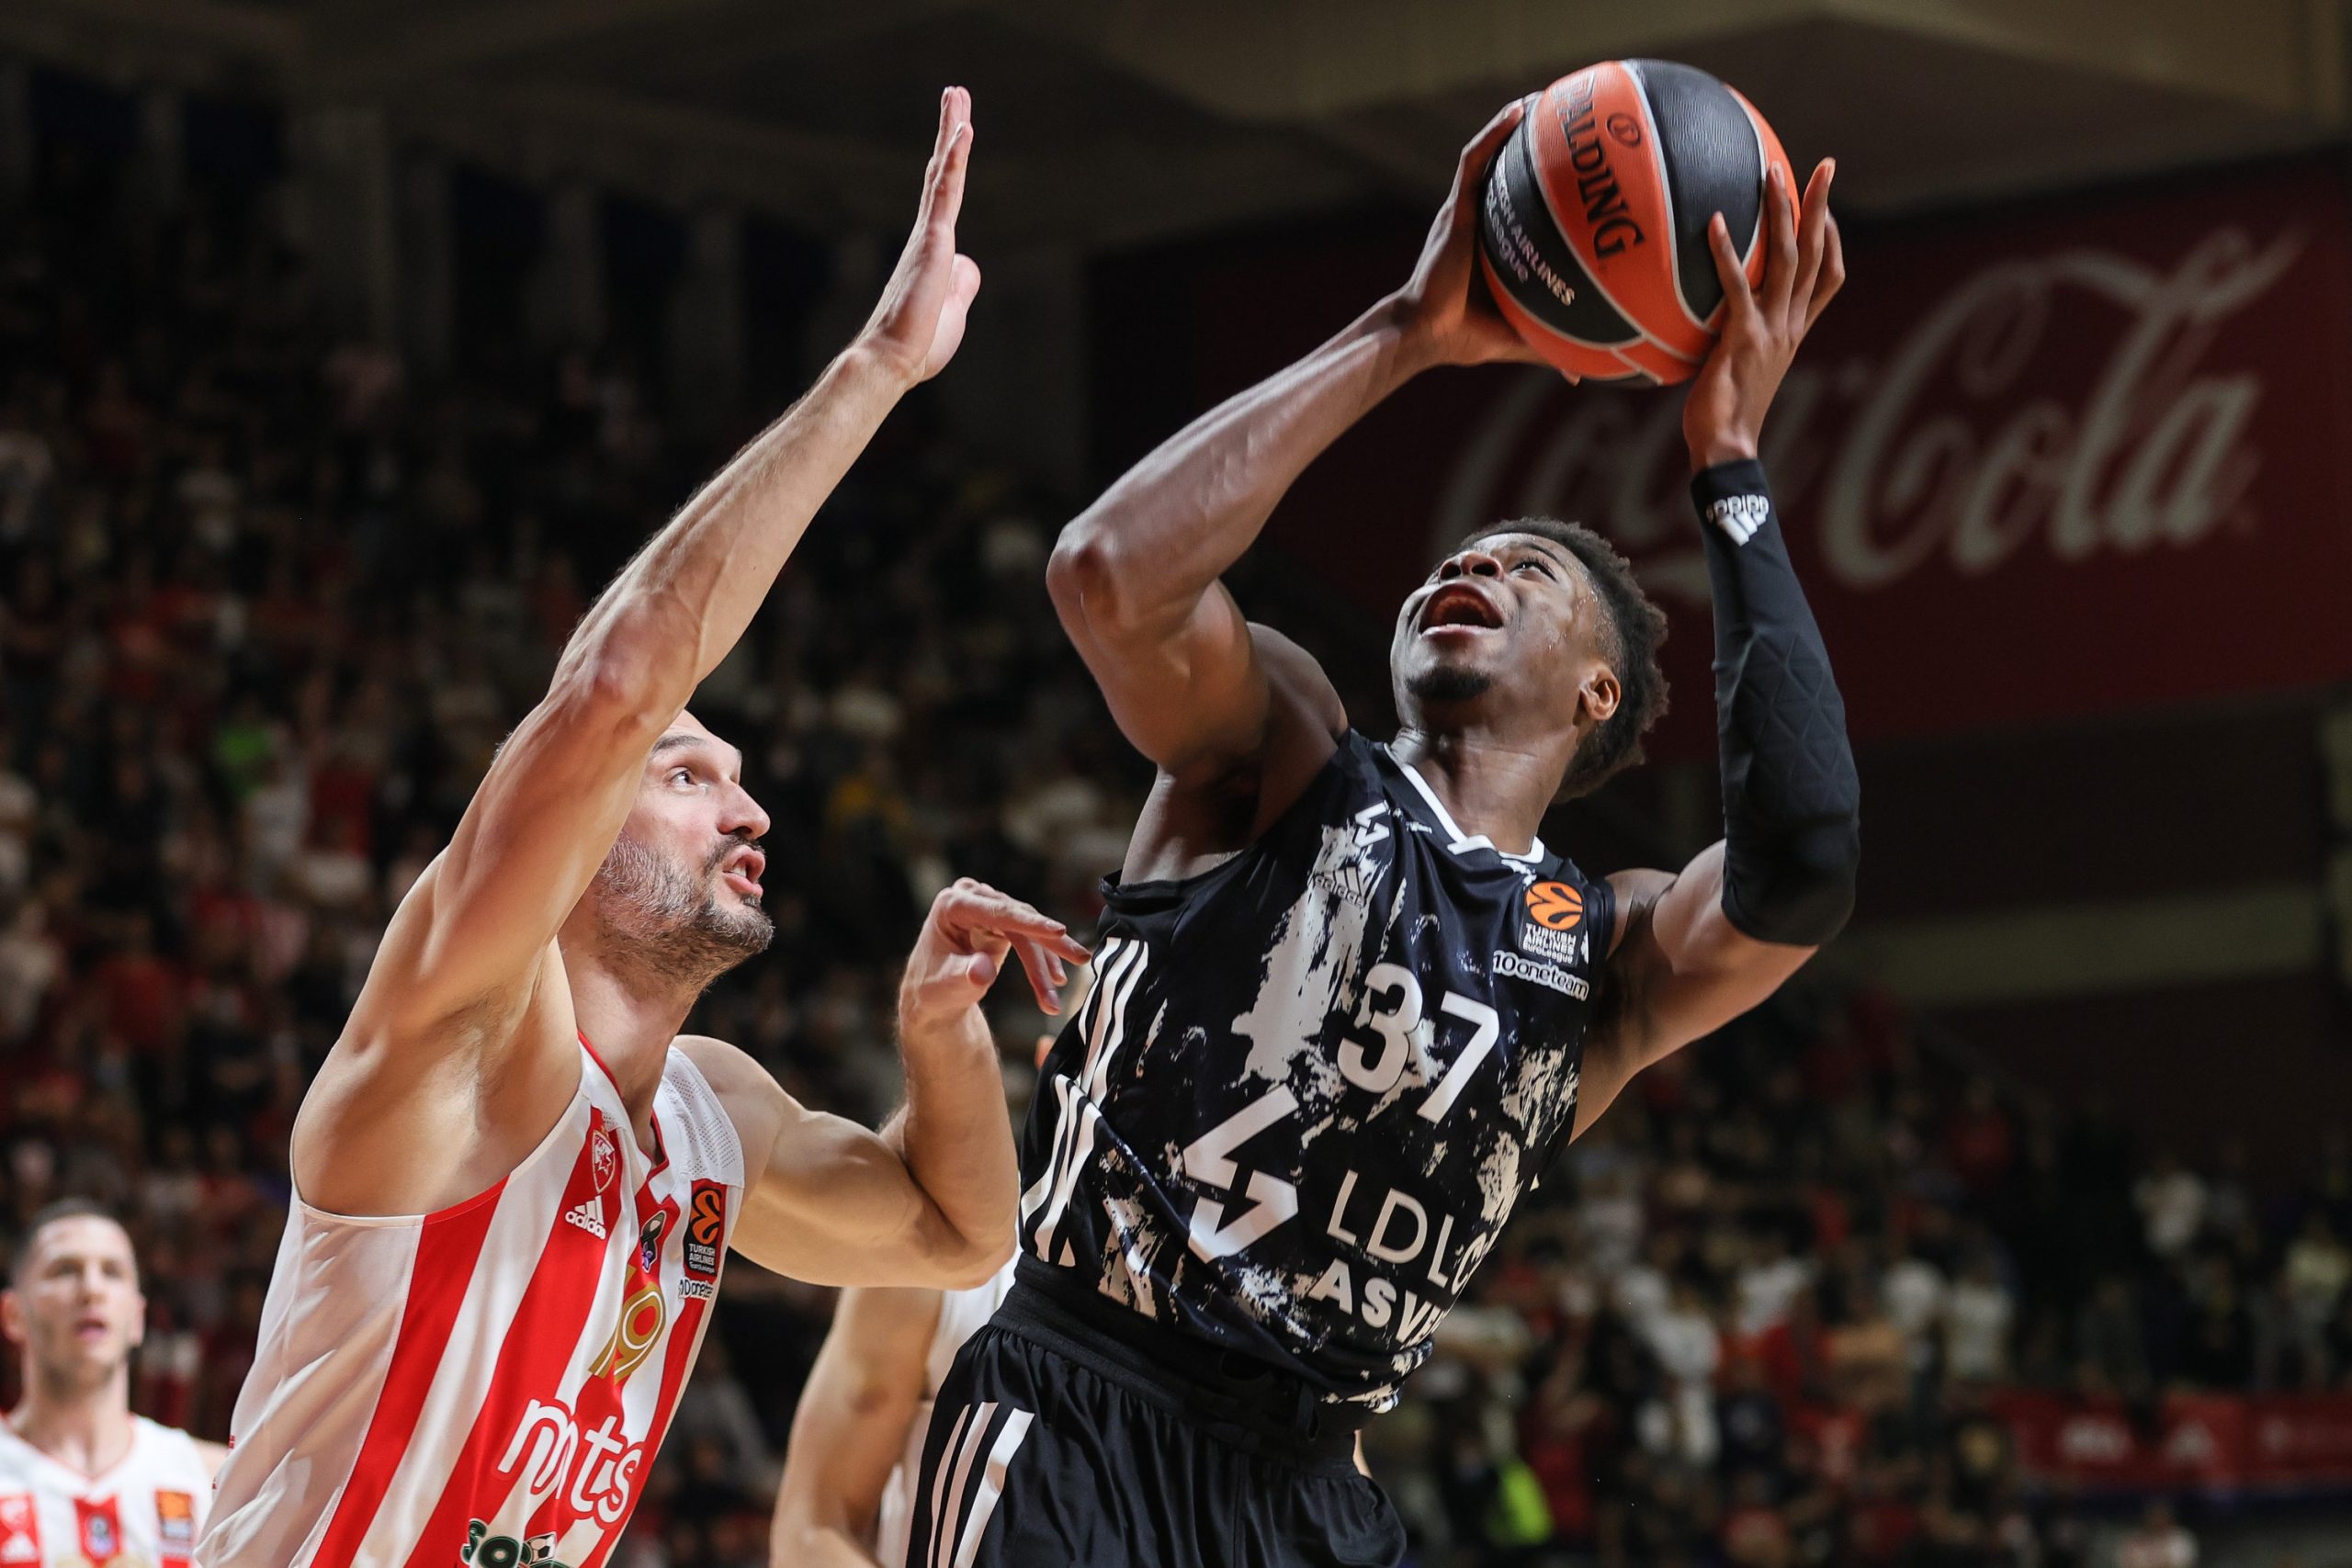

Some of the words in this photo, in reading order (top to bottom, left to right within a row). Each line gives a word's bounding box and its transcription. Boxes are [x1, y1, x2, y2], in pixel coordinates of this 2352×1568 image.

[1511, 223, 1575, 306] AIRLINES
[1523, 932, 1575, 956] AIRLINES
[1525, 922, 1577, 947] TURKISH
[1337, 963, 1499, 1124] 37
[565, 1211, 606, 1240] adidas
[688, 1243, 716, 1257] TURKISH
[688, 1252, 716, 1266] AIRLINES
[497, 1398, 642, 1523] mts
